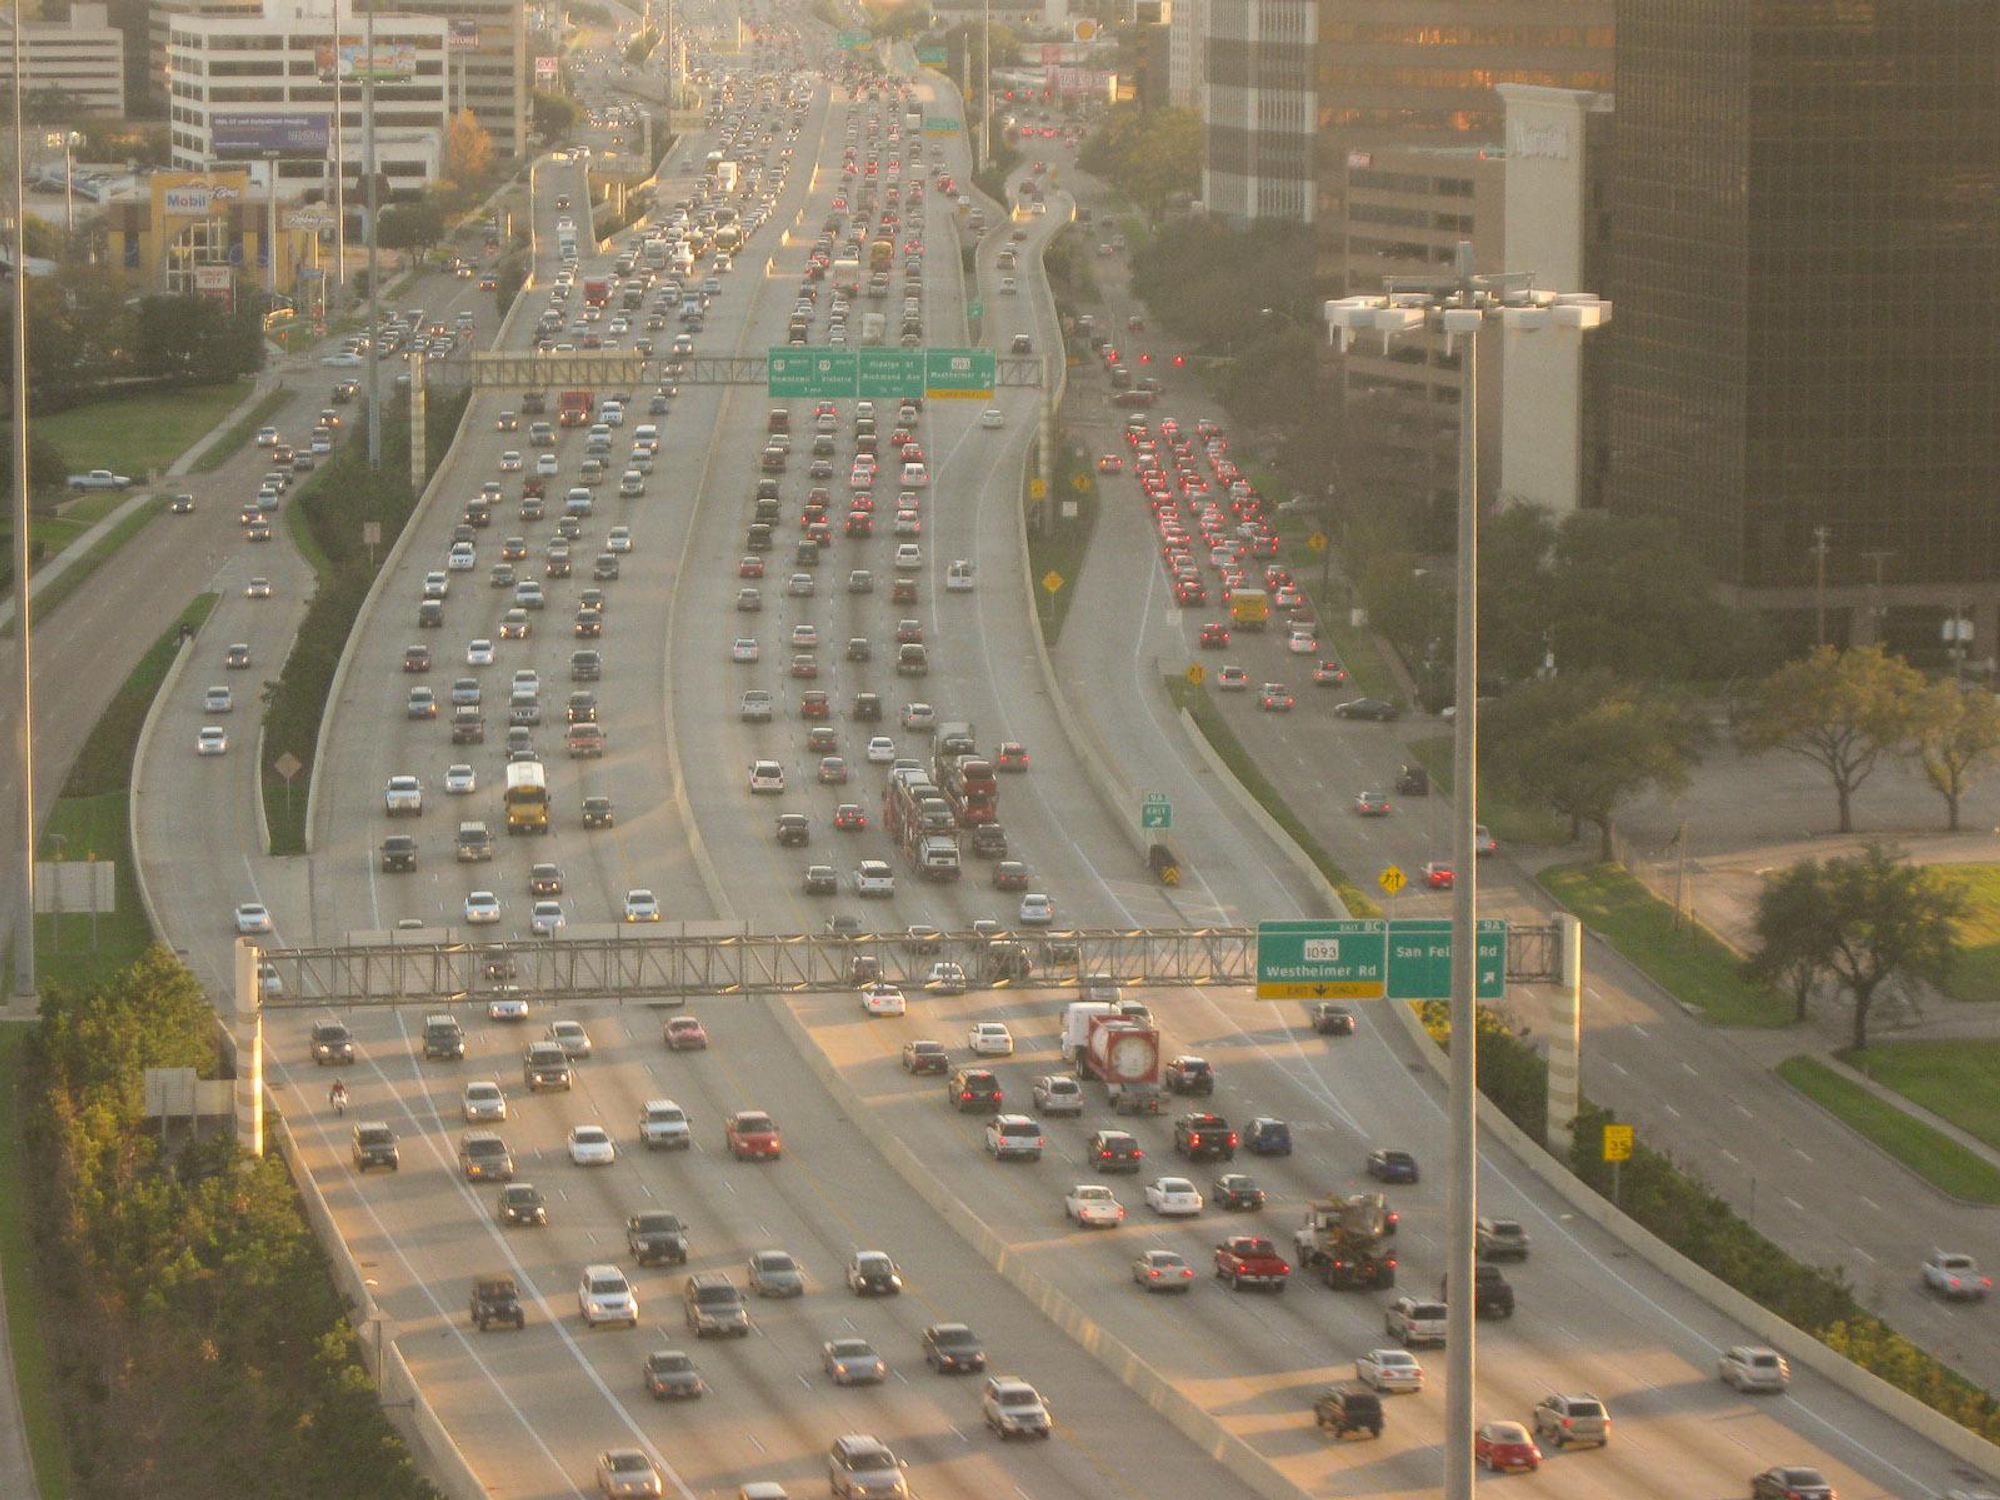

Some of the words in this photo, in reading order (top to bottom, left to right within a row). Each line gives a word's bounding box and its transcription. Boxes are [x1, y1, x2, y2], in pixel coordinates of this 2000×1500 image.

[167, 195, 206, 208] Mobil
[1306, 946, 1337, 959] 1093
[1396, 946, 1421, 957] San
[1429, 945, 1450, 957] Fel
[1480, 946, 1497, 957] Rd
[1266, 964, 1351, 977] Westheimer
[1359, 964, 1376, 976] Rd
